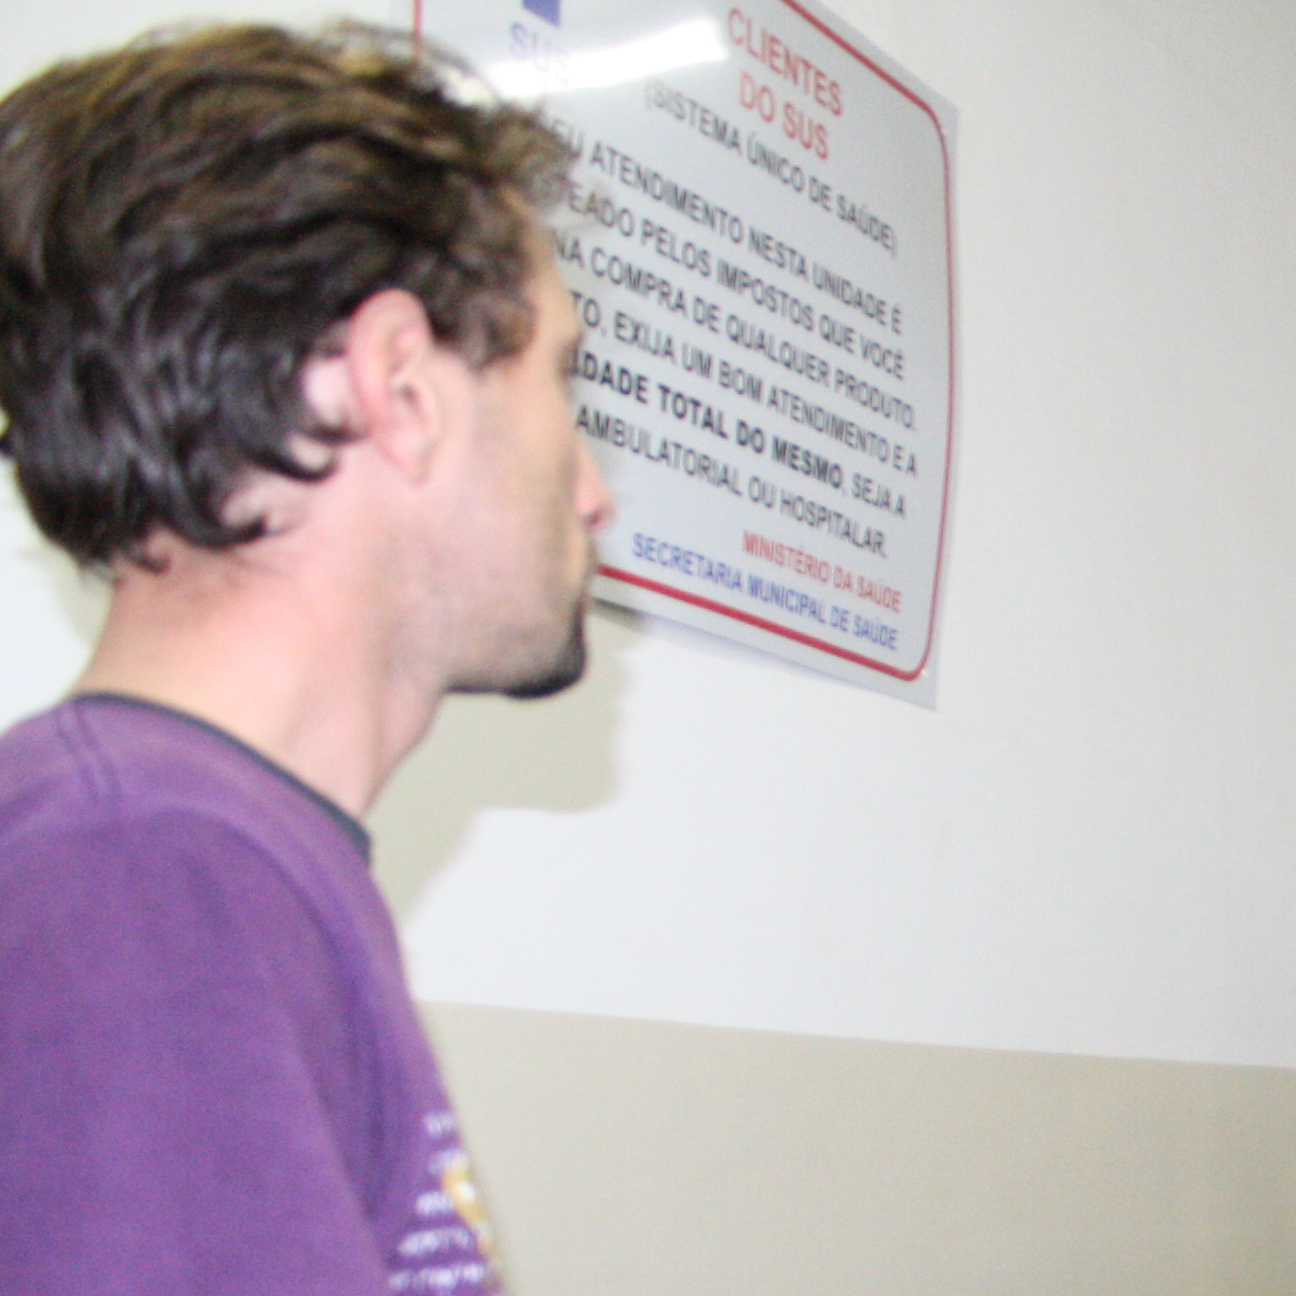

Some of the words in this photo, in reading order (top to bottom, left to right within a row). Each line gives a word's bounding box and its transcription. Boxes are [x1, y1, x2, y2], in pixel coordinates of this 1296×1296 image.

[728, 7, 843, 118] CLIENTES
[739, 70, 776, 124] DO
[783, 101, 829, 161] SUS
[589, 140, 743, 245] ATENDIMENTO
[748, 225, 810, 283] NESTA
[812, 260, 888, 328] UNIDADE
[745, 130, 804, 196] ÚNICO
[808, 175, 834, 212] DE
[835, 195, 897, 261] SAÚDE)
[591, 246, 688, 318] COMPRA
[692, 295, 722, 334] DE
[725, 313, 830, 390] QUALQUER
[641, 217, 712, 278] PELOS
[716, 258, 814, 333] IMPOSTOS
[818, 313, 857, 355] QUE
[574, 402, 744, 498] AMBULATORIAL
[748, 475, 777, 510] OU
[613, 310, 677, 366] EXIJA
[681, 341, 713, 379] UM
[718, 358, 764, 404] BOM
[766, 384, 890, 464] ATENDIMENTO
[892, 443, 904, 472] E
[905, 451, 919, 478] A
[656, 380, 729, 440] TOTAL
[735, 417, 766, 454] DO
[851, 470, 893, 514] SEJA
[893, 493, 907, 521] A
[632, 531, 743, 593] SECRETARIA
[746, 572, 828, 625] MUNICIPAL
[829, 604, 850, 634] DE
[851, 613, 899, 651] SAÚDE
[742, 529, 833, 585] MINISTÉRIO
[832, 564, 853, 593] DA
[854, 572, 903, 614] SAÚDE
